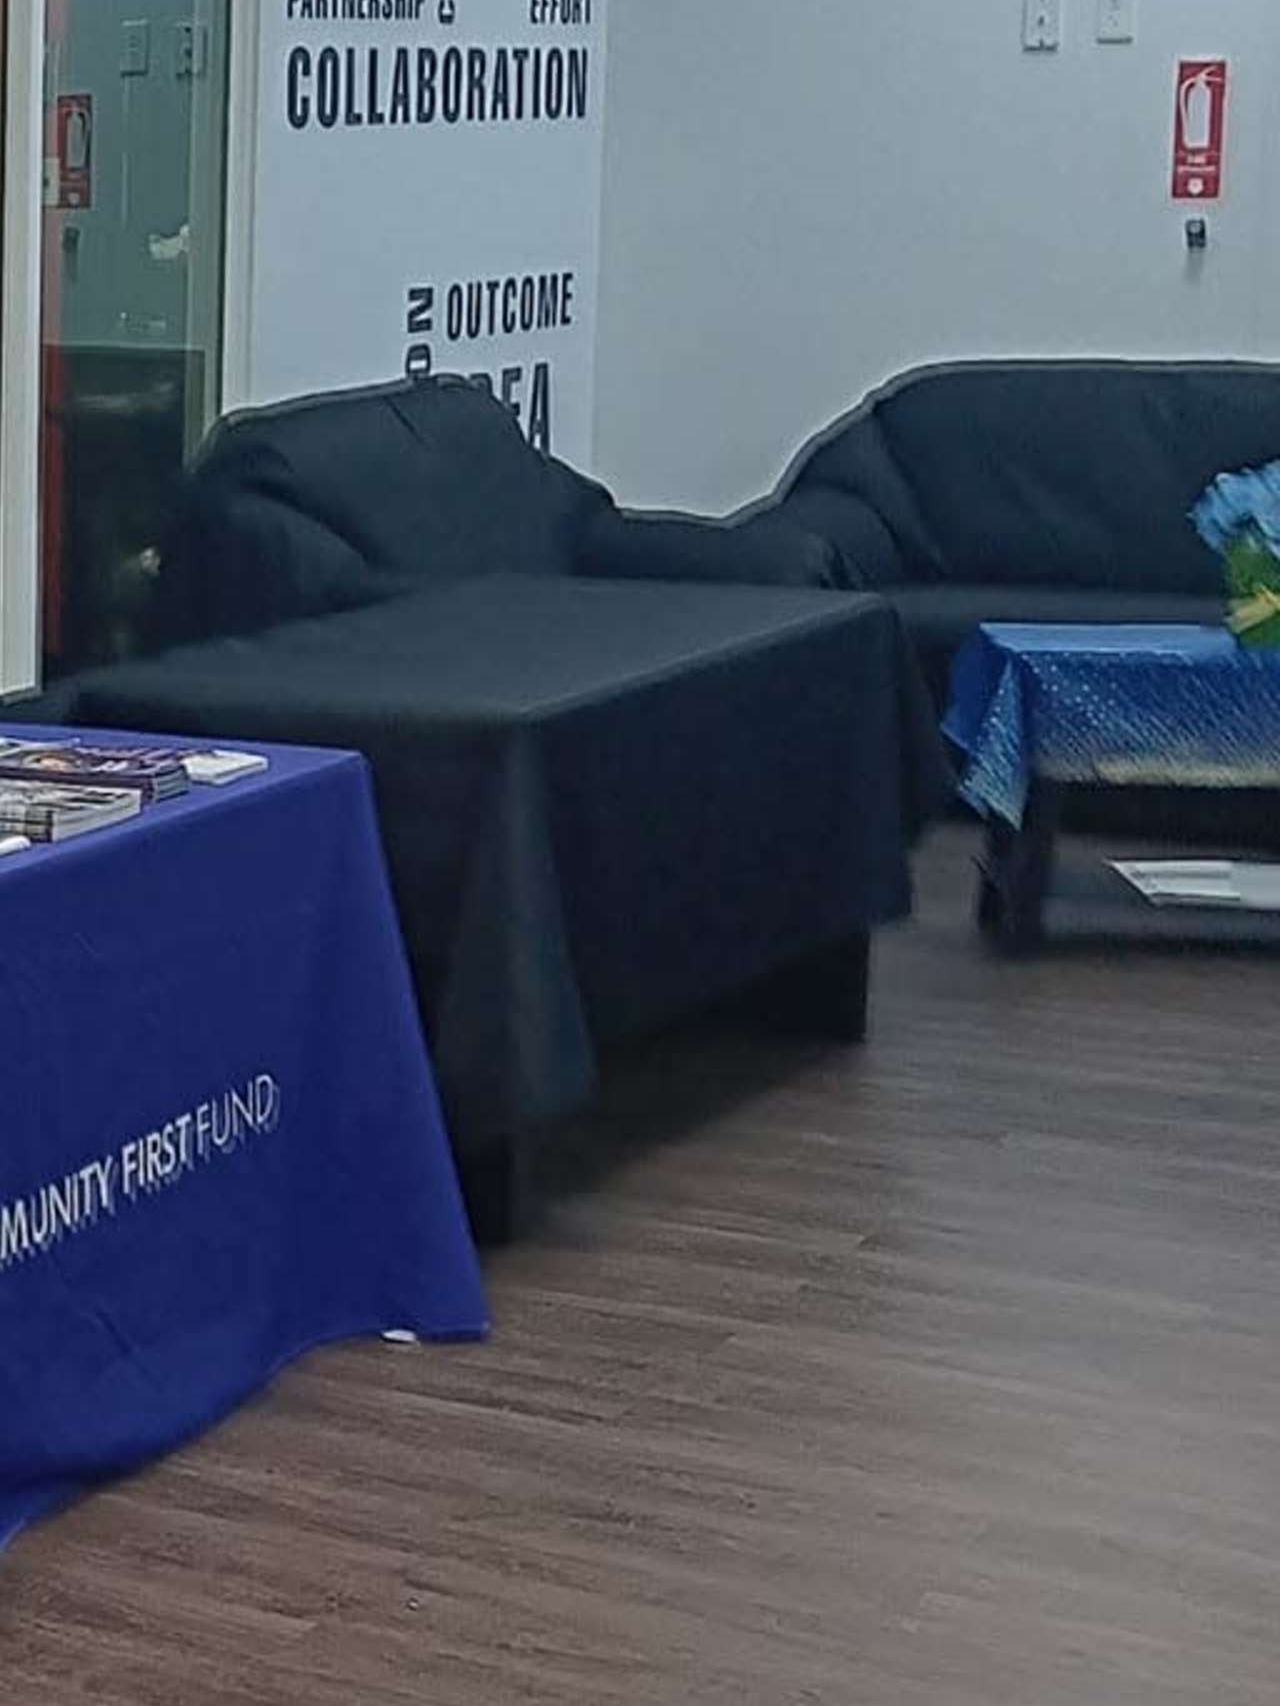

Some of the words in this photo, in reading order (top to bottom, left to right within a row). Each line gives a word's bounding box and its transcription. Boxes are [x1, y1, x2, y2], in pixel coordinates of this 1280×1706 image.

[286, 45, 589, 130] COLLABORATION
[446, 272, 574, 341] OUTCOME
[122, 1114, 192, 1196] FIRST
[196, 1074, 277, 1156] FUND
